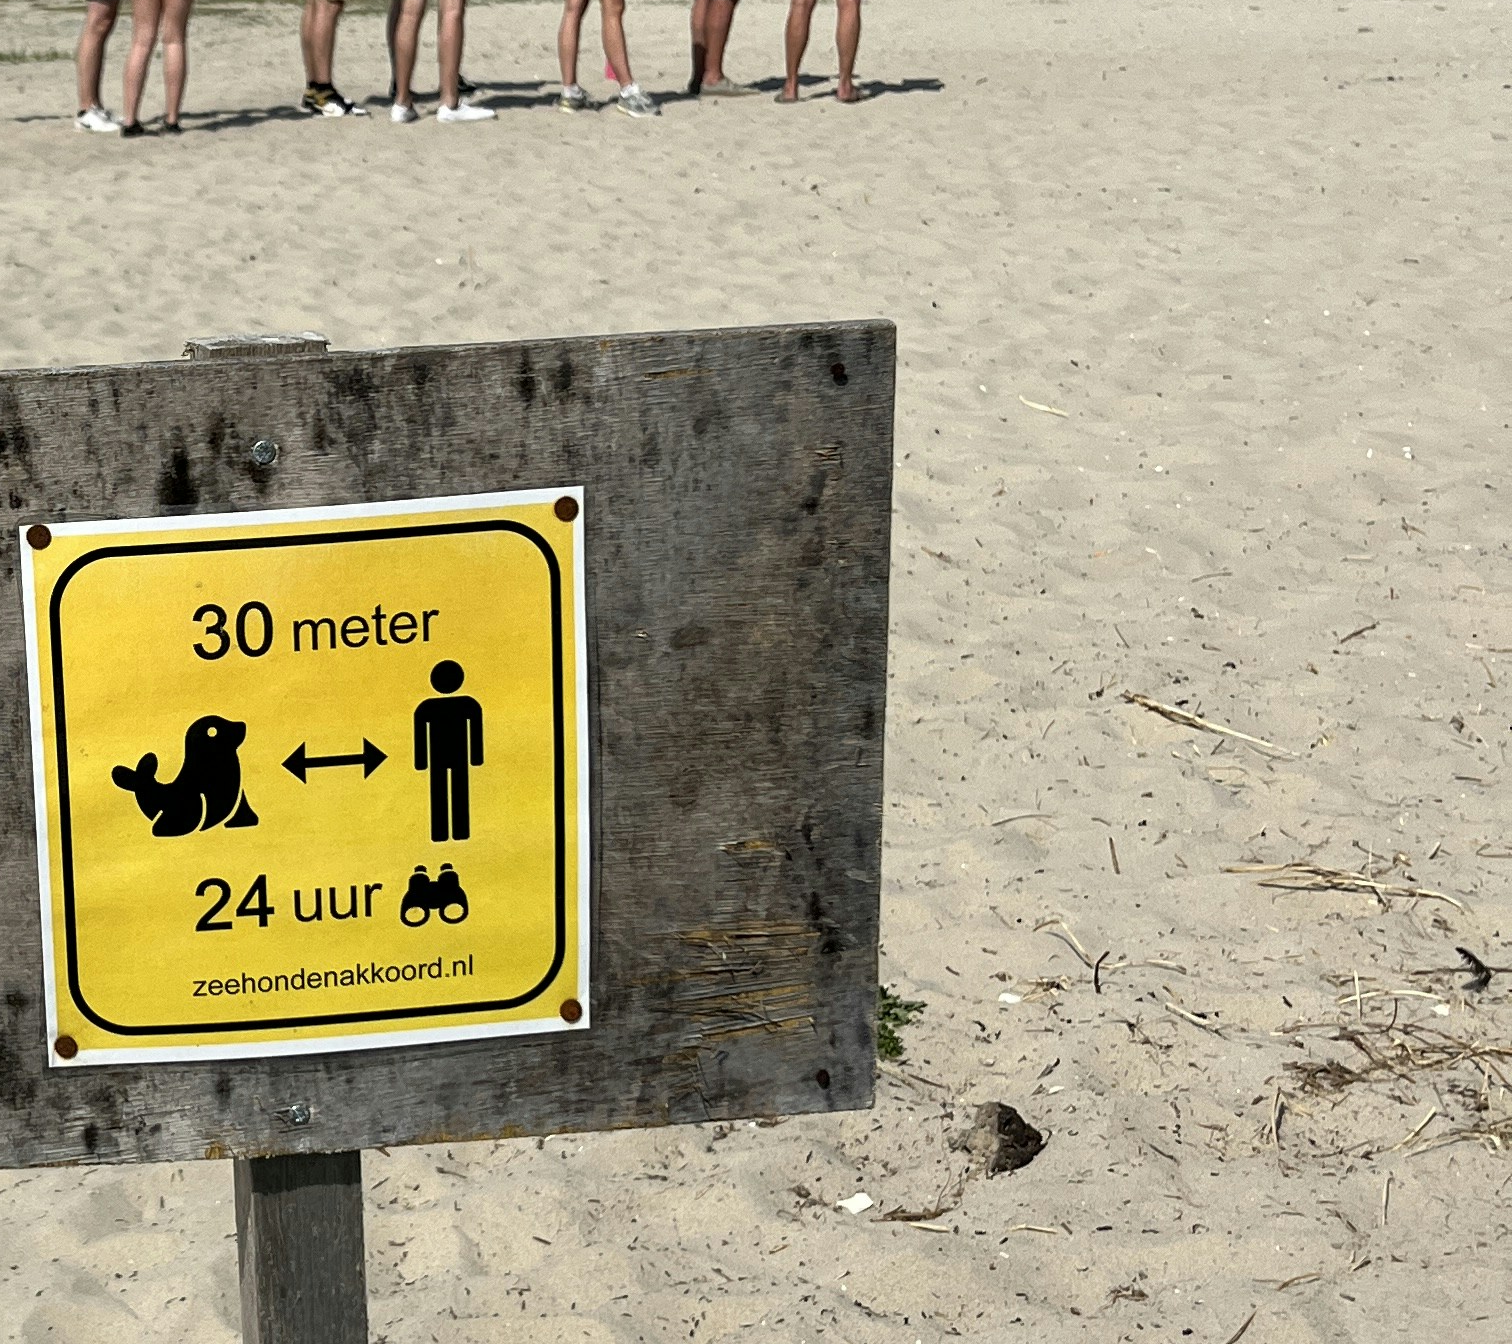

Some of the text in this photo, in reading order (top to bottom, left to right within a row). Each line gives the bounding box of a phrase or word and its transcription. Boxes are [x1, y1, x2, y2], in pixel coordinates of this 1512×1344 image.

[192, 600, 439, 661] 30 meter
[195, 874, 383, 932] 24 uur
[192, 954, 474, 997] zeehondenakkoord.nl
